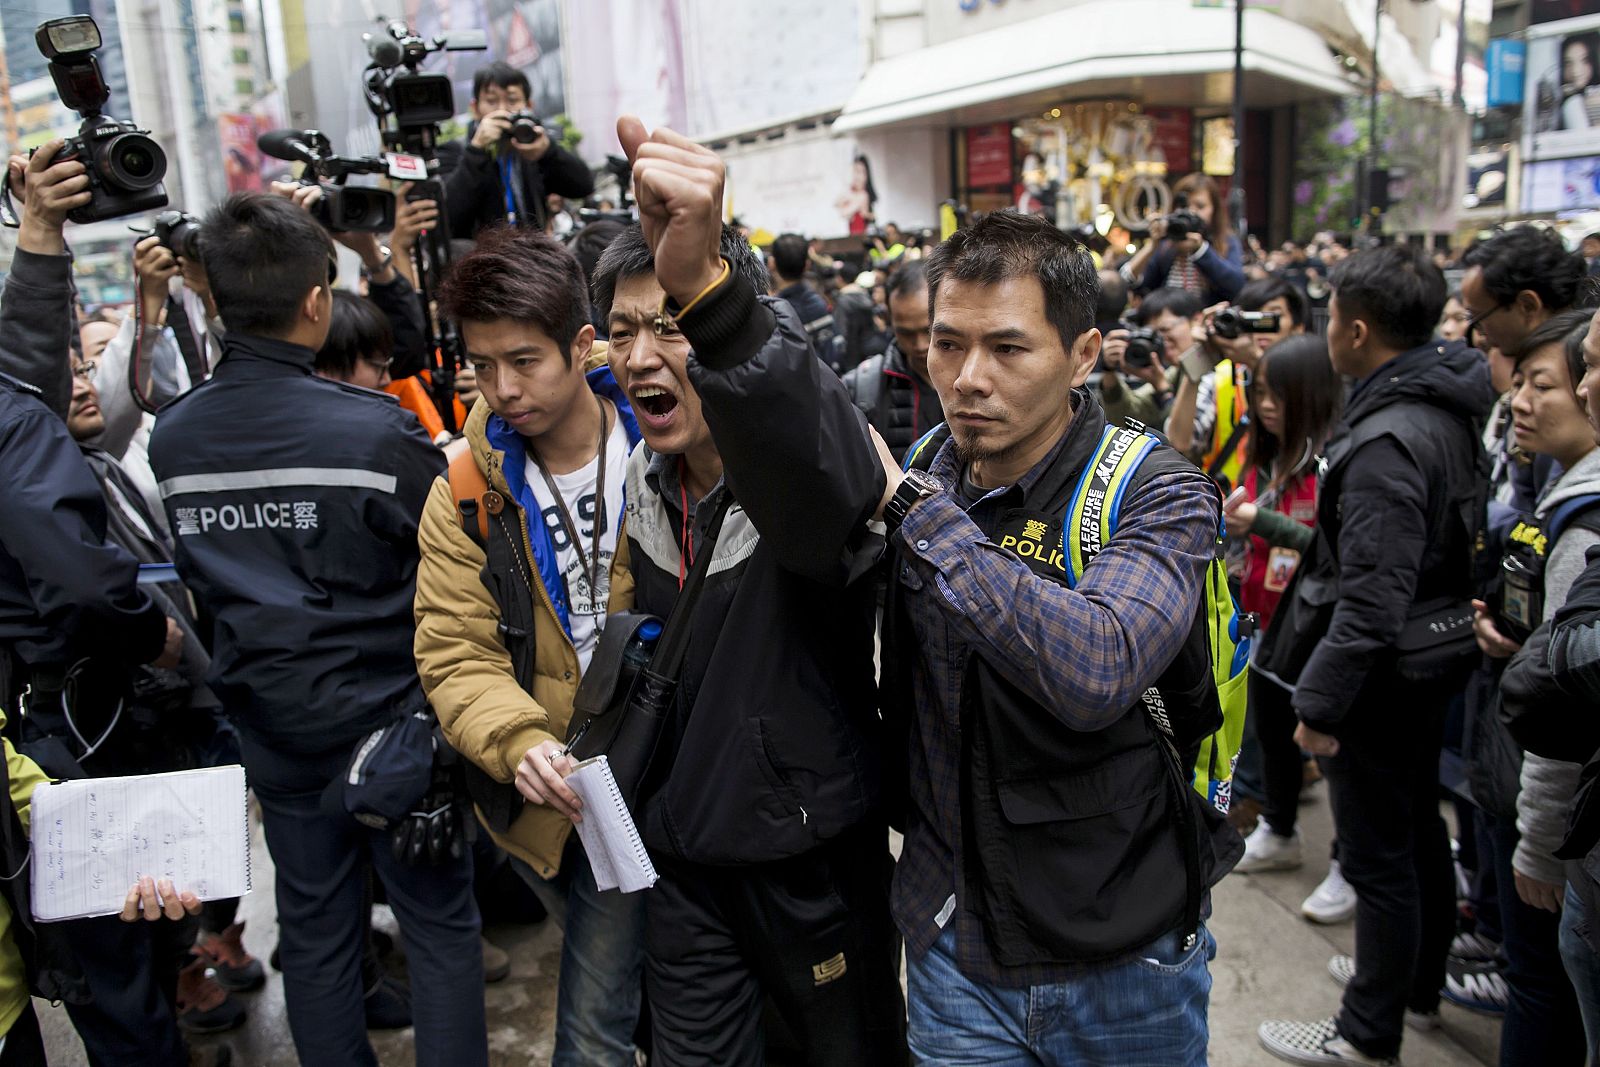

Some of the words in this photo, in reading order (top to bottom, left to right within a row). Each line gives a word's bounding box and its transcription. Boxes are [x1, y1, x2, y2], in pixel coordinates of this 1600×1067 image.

[96, 126, 119, 136] Nikon
[1081, 488, 1097, 553] LEISURE
[1091, 489, 1105, 520] LIFE
[1000, 535, 1067, 572] POLIC
[1147, 687, 1175, 736] EISURE
